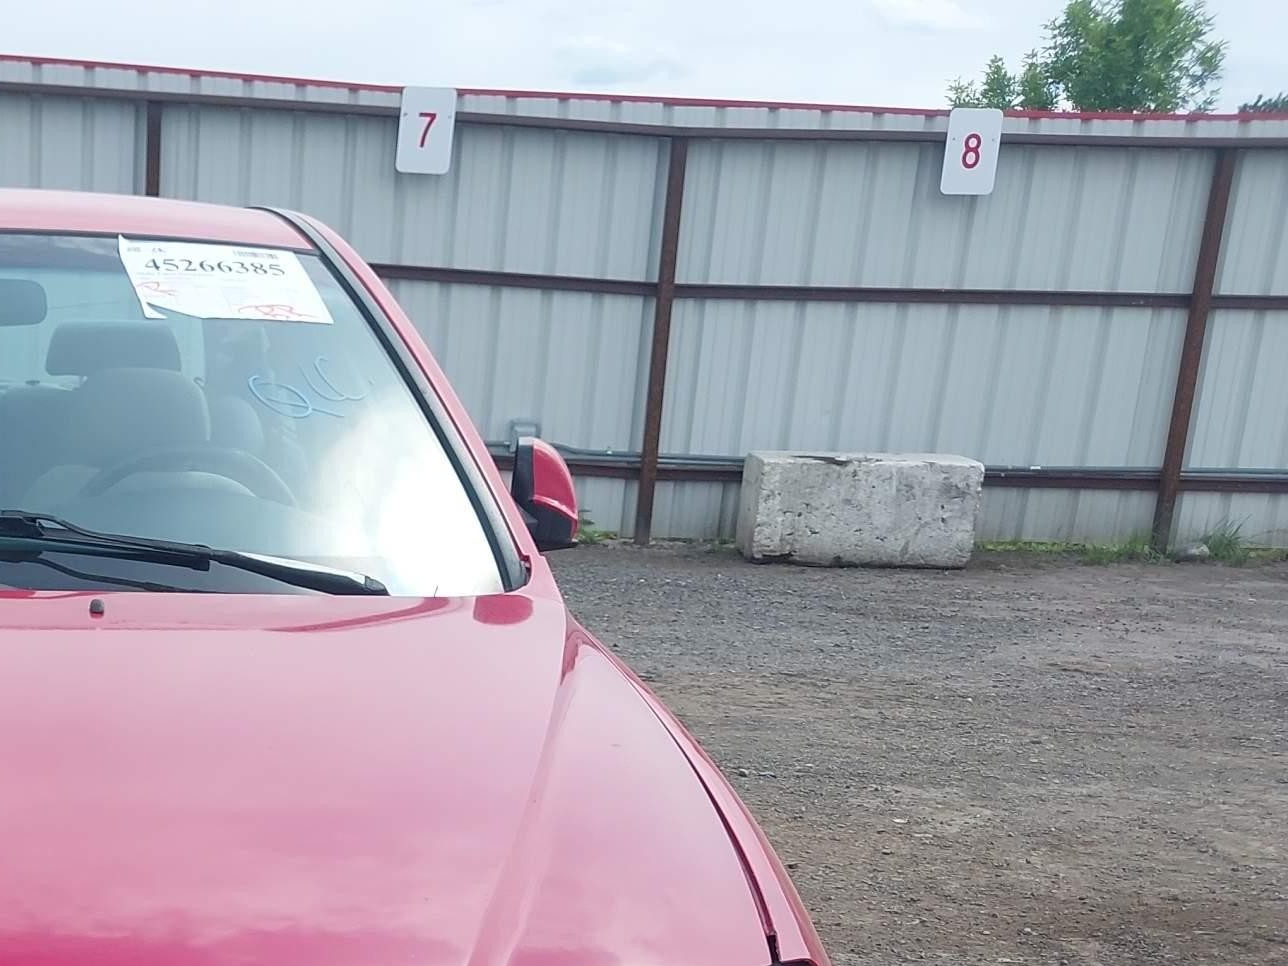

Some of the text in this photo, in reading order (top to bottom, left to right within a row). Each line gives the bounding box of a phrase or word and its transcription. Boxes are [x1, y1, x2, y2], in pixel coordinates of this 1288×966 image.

[418, 112, 437, 148] 7
[961, 133, 982, 169] 8
[144, 258, 286, 277] 45266385
